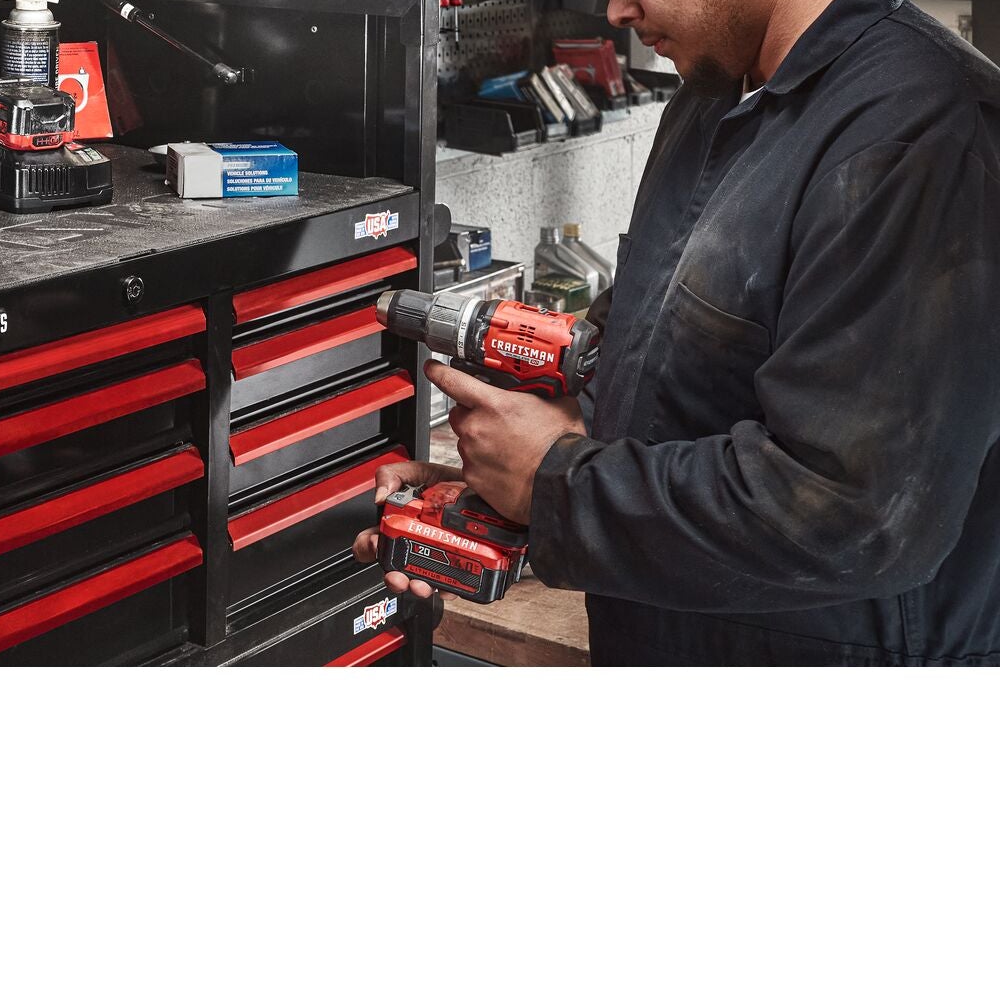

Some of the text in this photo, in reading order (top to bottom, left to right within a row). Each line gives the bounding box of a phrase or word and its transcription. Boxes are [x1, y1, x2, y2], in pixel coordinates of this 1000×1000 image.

[367, 214, 386, 235] USA
[491, 338, 555, 363] CRAFTSMAN
[407, 520, 479, 551] CRAFTSMAN
[409, 565, 458, 585] LITHIUM ION
[365, 602, 386, 627] USA
